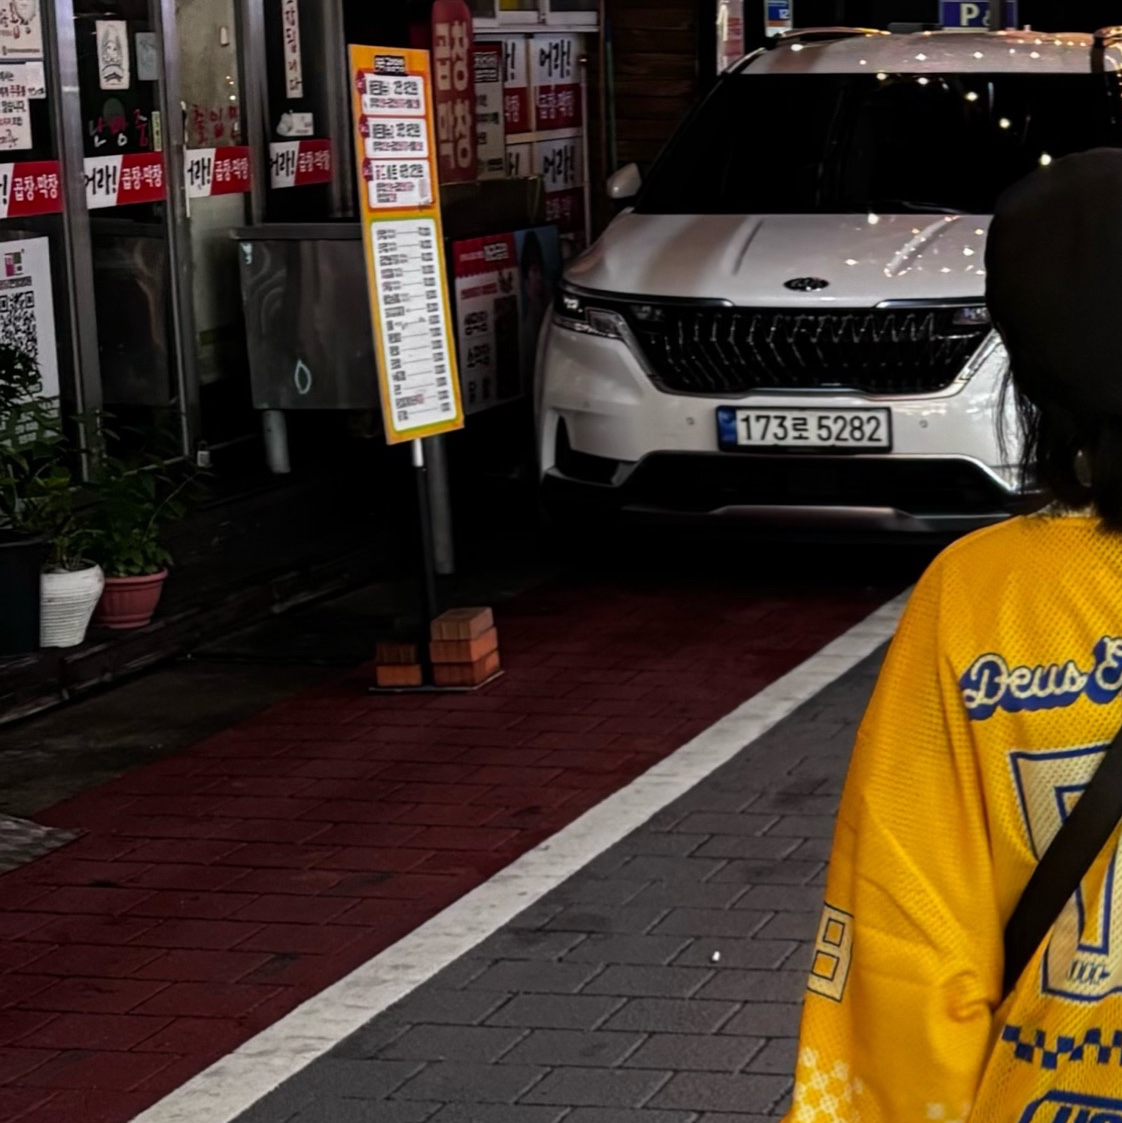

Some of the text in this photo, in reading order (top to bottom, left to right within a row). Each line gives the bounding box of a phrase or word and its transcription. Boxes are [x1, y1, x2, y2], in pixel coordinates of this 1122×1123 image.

[434, 20, 469, 92] 곱창
[437, 98, 473, 169] 막창
[740, 414, 883, 442] 173로 5282
[961, 652, 1089, 721] Deus
